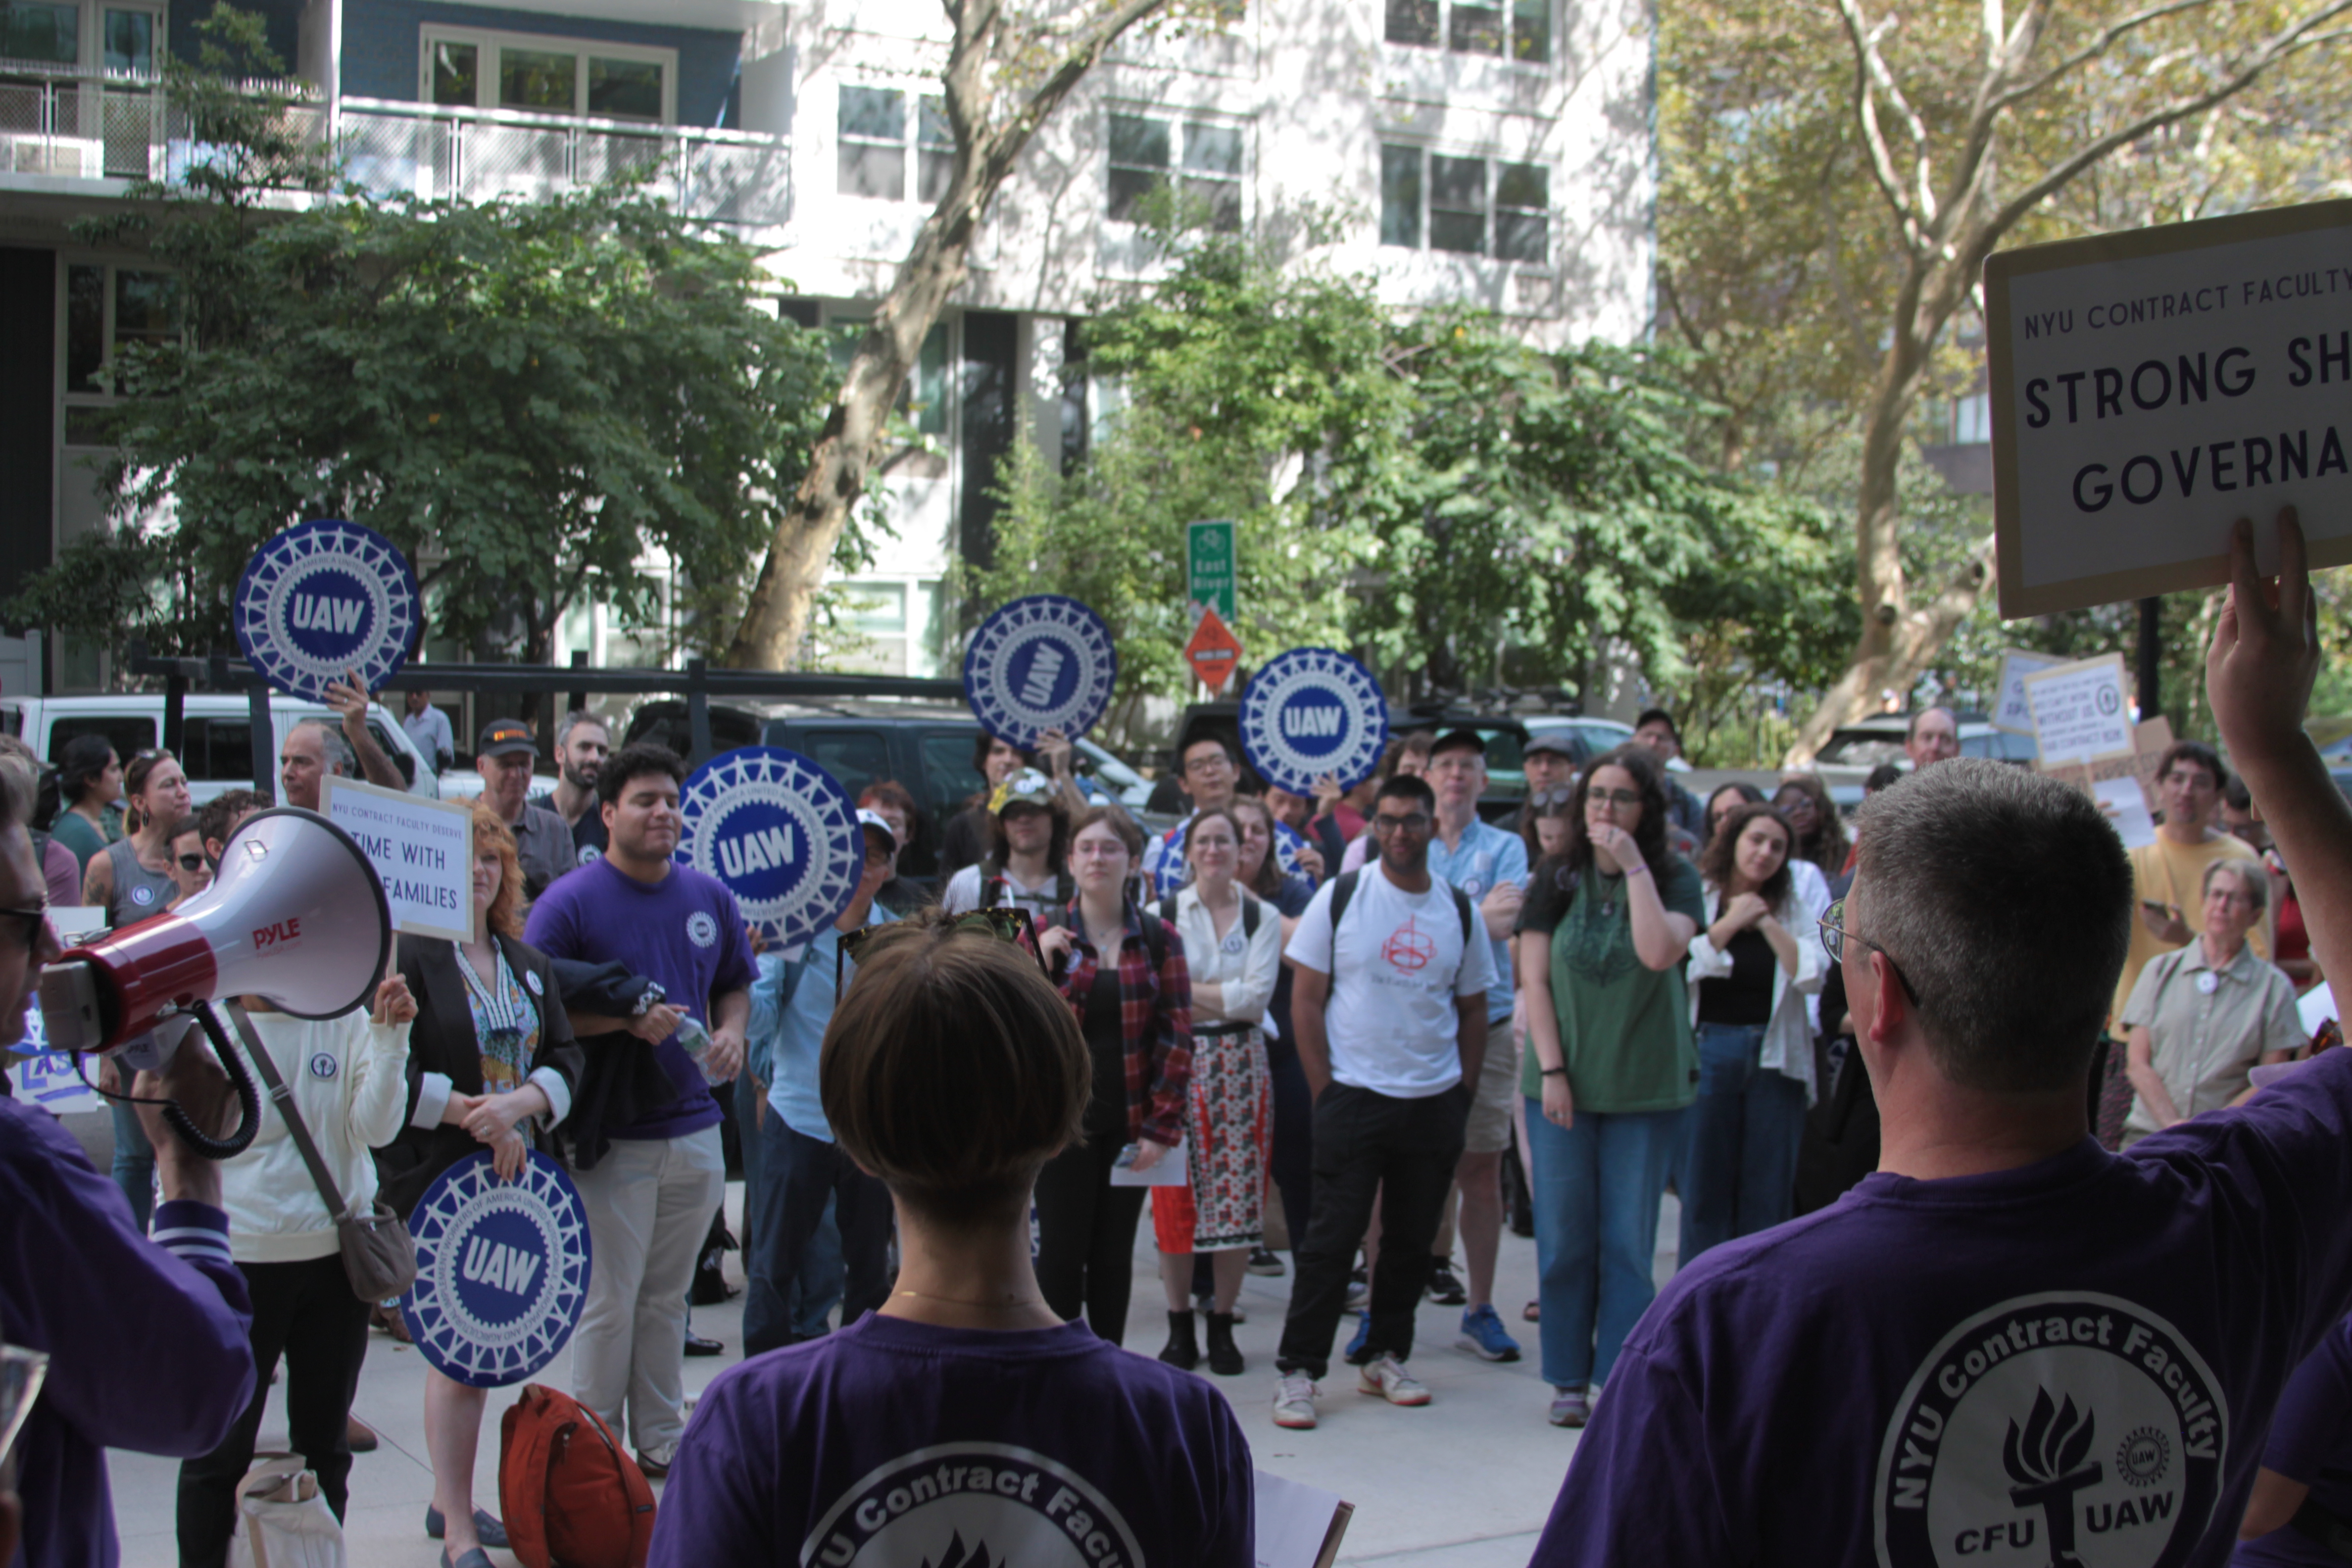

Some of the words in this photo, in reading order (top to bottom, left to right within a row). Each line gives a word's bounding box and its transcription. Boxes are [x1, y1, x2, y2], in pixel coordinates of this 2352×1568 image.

[2024, 309, 2074, 340] NYU
[2087, 285, 2229, 329] CONTRACT
[2243, 267, 2352, 305] FACULTY
[2024, 346, 2257, 429] STRONG
[2288, 331, 2352, 387] SH
[2072, 426, 2349, 513] GOVERNA
[293, 593, 365, 635] UAW
[1020, 642, 1065, 707] UAW
[1284, 706, 1342, 737] UAW
[333, 802, 348, 815] NYU
[351, 807, 394, 824] CONTRACT
[396, 816, 430, 832] FACULTY
[433, 824, 463, 840] DESERVE
[351, 831, 392, 860] TIME
[402, 841, 445, 870] WITH
[719, 823, 794, 879] UAW
[383, 876, 458, 910] FAMILIES
[252, 917, 301, 950] PYLE
[473, 1199, 483, 1212] OF
[486, 1192, 522, 1205] AMERICA
[523, 1197, 547, 1221] UNITED
[444, 1208, 473, 1249] WORKERS
[463, 1234, 541, 1296] UAW
[1894, 1404, 1944, 1509] NYU
[1938, 1315, 2113, 1398] Contract
[2122, 1323, 2218, 1460] Faculty
[2132, 1449, 2155, 1465] UAW
[855, 1463, 1040, 1532] Contract
[2086, 1490, 2174, 1533] UAW
[1954, 1519, 2035, 1555] CFU
